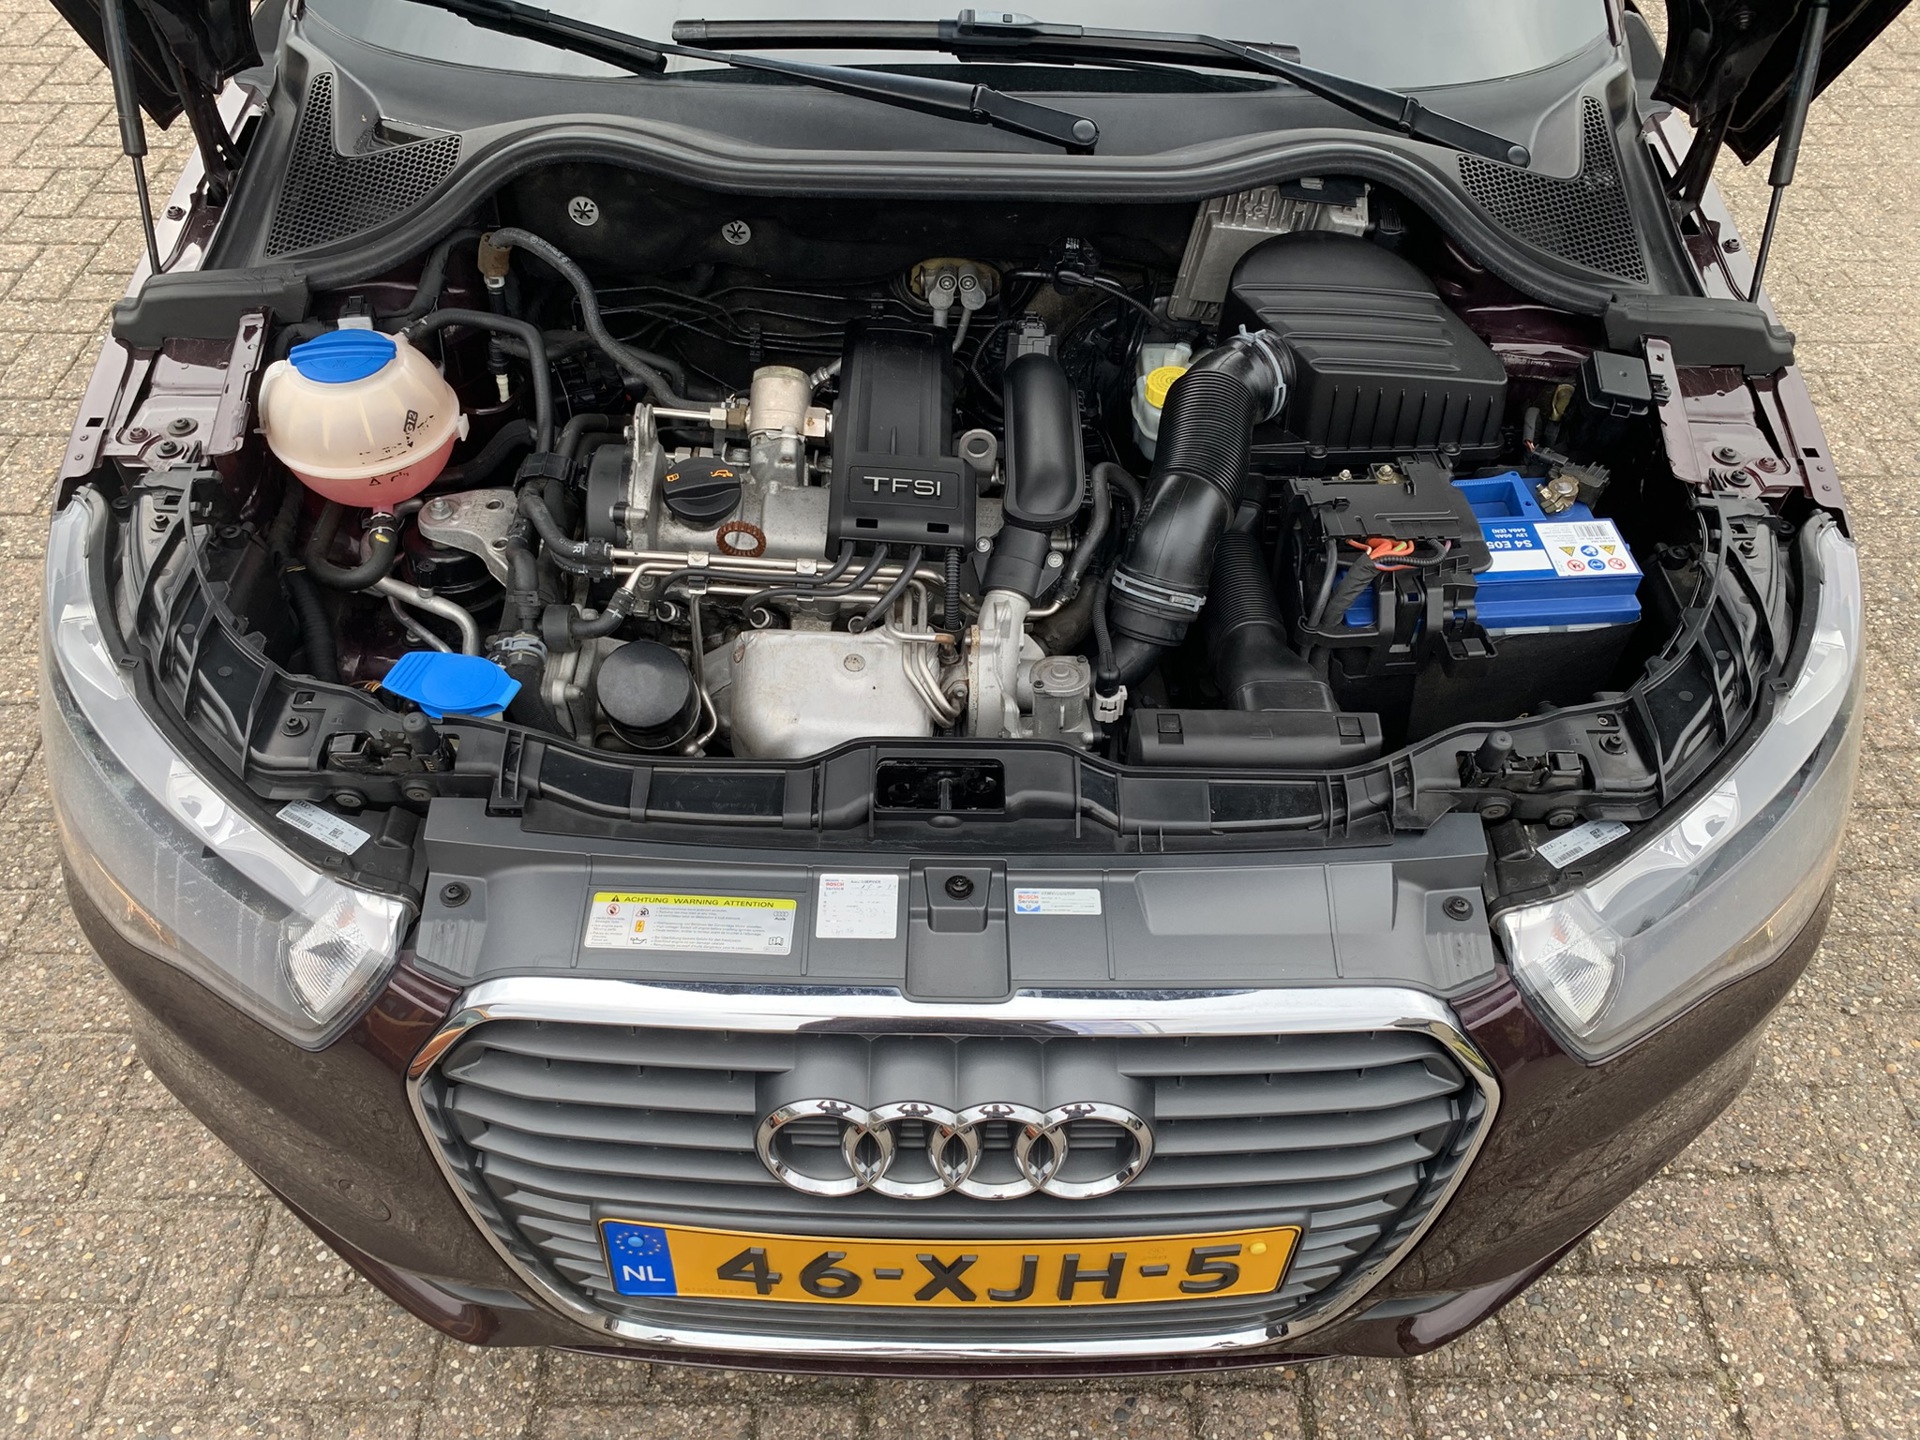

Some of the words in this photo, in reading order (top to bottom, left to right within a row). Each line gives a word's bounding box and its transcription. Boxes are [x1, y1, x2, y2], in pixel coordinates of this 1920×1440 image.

[863, 476, 941, 496] TFSI
[1514, 539, 1533, 548] S4
[623, 896, 669, 904] ACHTUNG
[673, 898, 719, 906] WARNING
[723, 900, 775, 908] ATTENTION
[622, 1265, 666, 1282] NL
[717, 1244, 1242, 1301] 46-XJH-5
